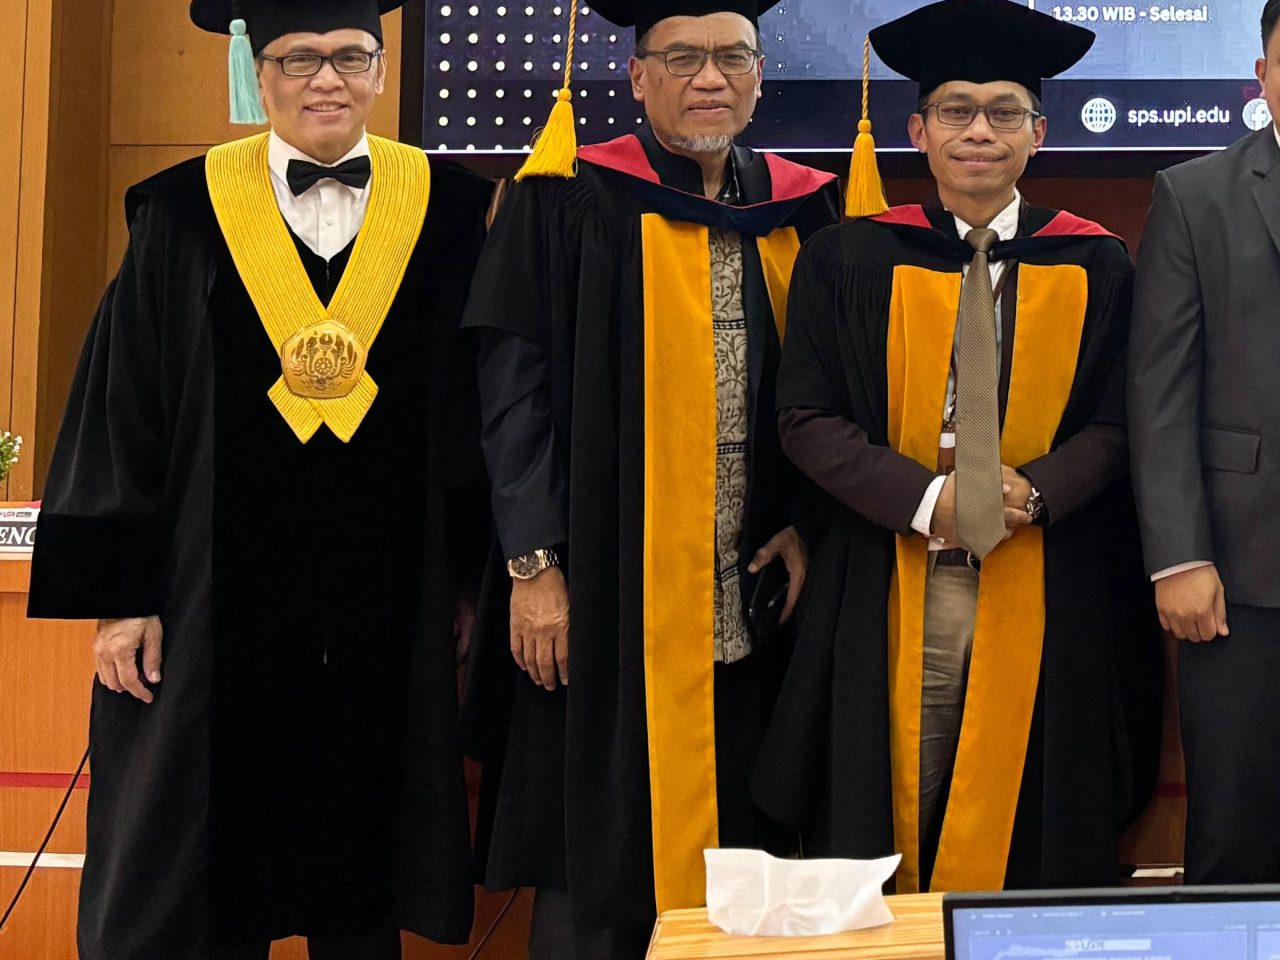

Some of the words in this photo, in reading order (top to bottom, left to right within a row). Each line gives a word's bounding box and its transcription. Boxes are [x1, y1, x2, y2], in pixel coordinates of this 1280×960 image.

[1053, 6, 1099, 21] 13.30
[1102, 6, 1136, 21] WIB
[1150, 5, 1208, 21] Selesai
[1127, 106, 1230, 129] sps.upi.edu
